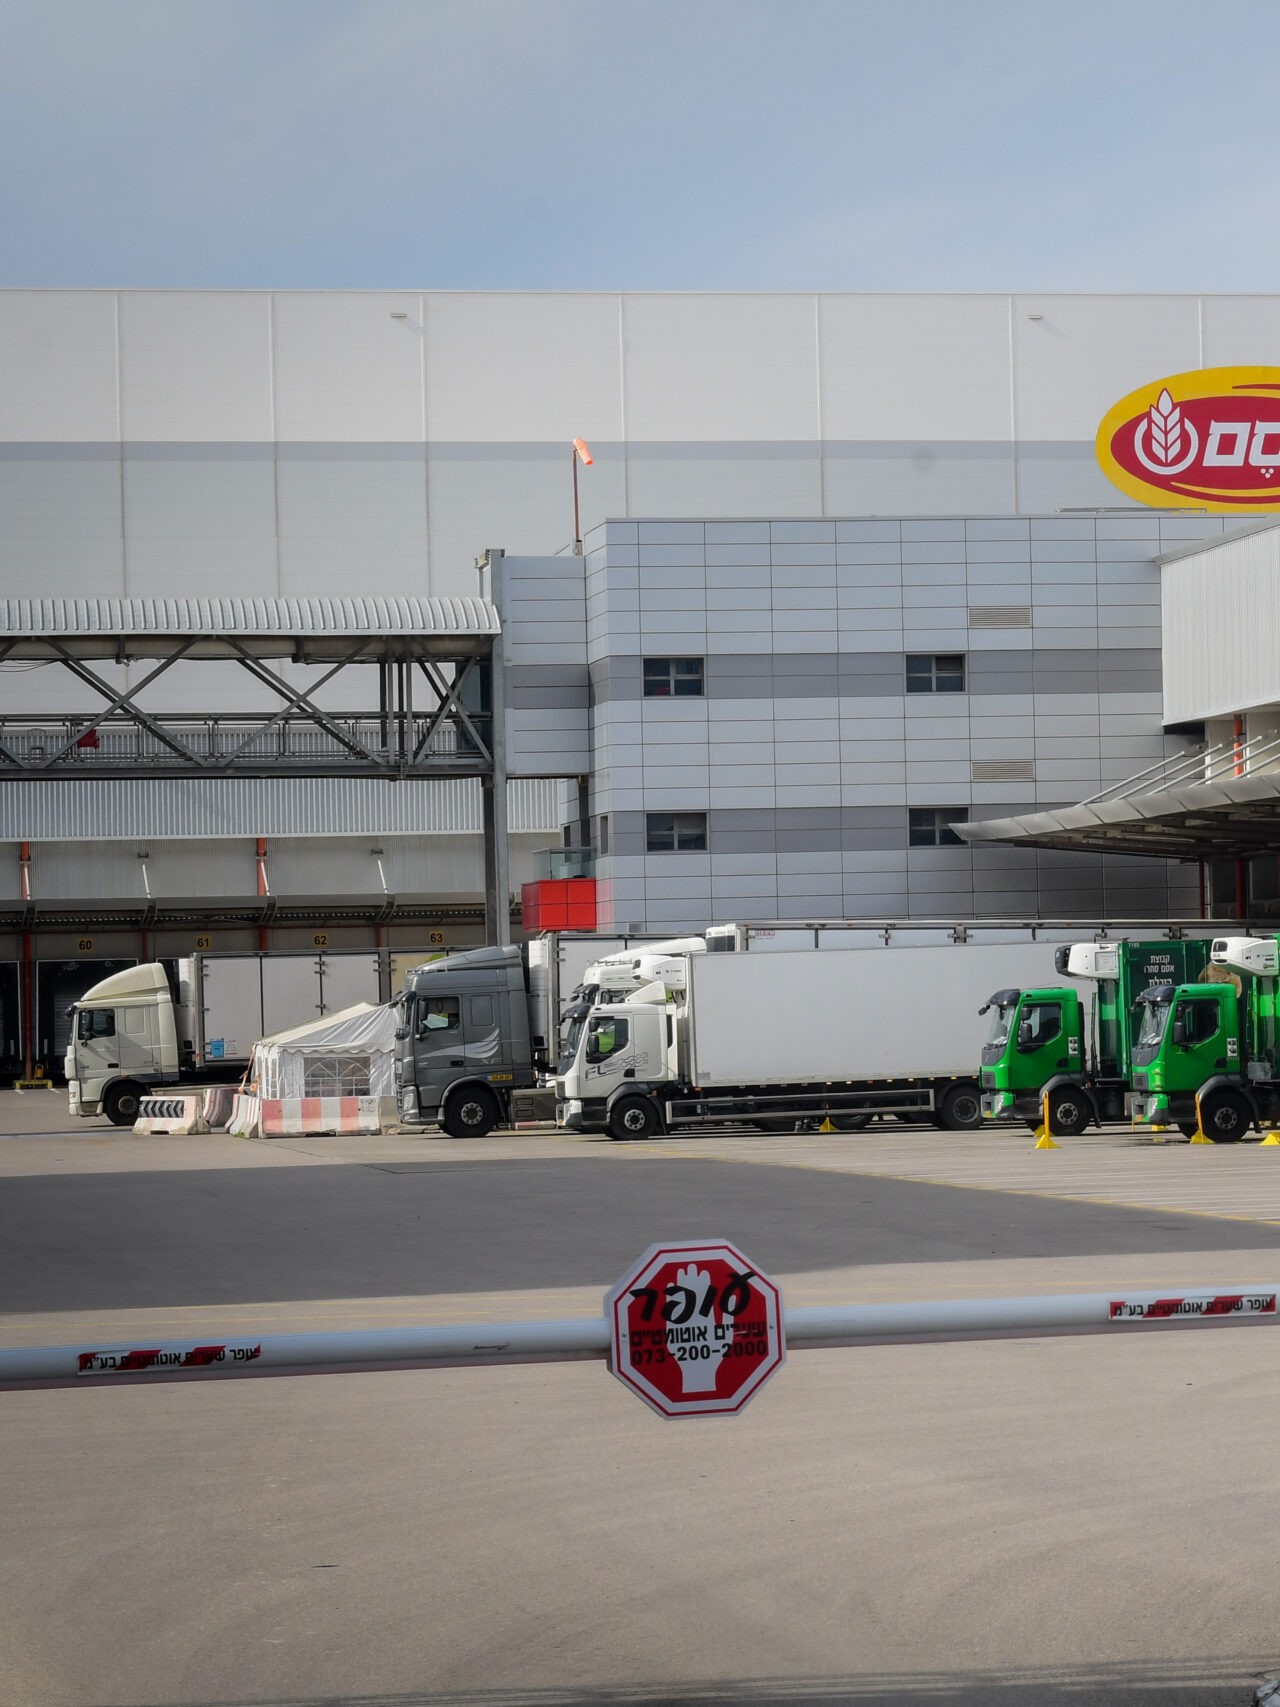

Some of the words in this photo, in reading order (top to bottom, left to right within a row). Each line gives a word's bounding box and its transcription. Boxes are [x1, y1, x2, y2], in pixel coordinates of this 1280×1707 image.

[197, 937, 209, 948] 61
[314, 935, 327, 945] 62
[430, 933, 443, 943] 63
[79, 940, 92, 951] 60
[1150, 954, 1170, 964] קבוצת
[1160, 964, 1175, 973] אסם
[629, 1271, 756, 1324] עופר
[1147, 1301, 1203, 1315] אוטומטיים
[1206, 1300, 1244, 1313] שערים
[630, 1325, 708, 1347] אוטומטיים
[714, 1321, 767, 1341] שערים
[120, 1351, 181, 1367] אוטומטיים
[185, 1349, 226, 1364] שערים
[631, 1340, 768, 1365] 073-200-2000
